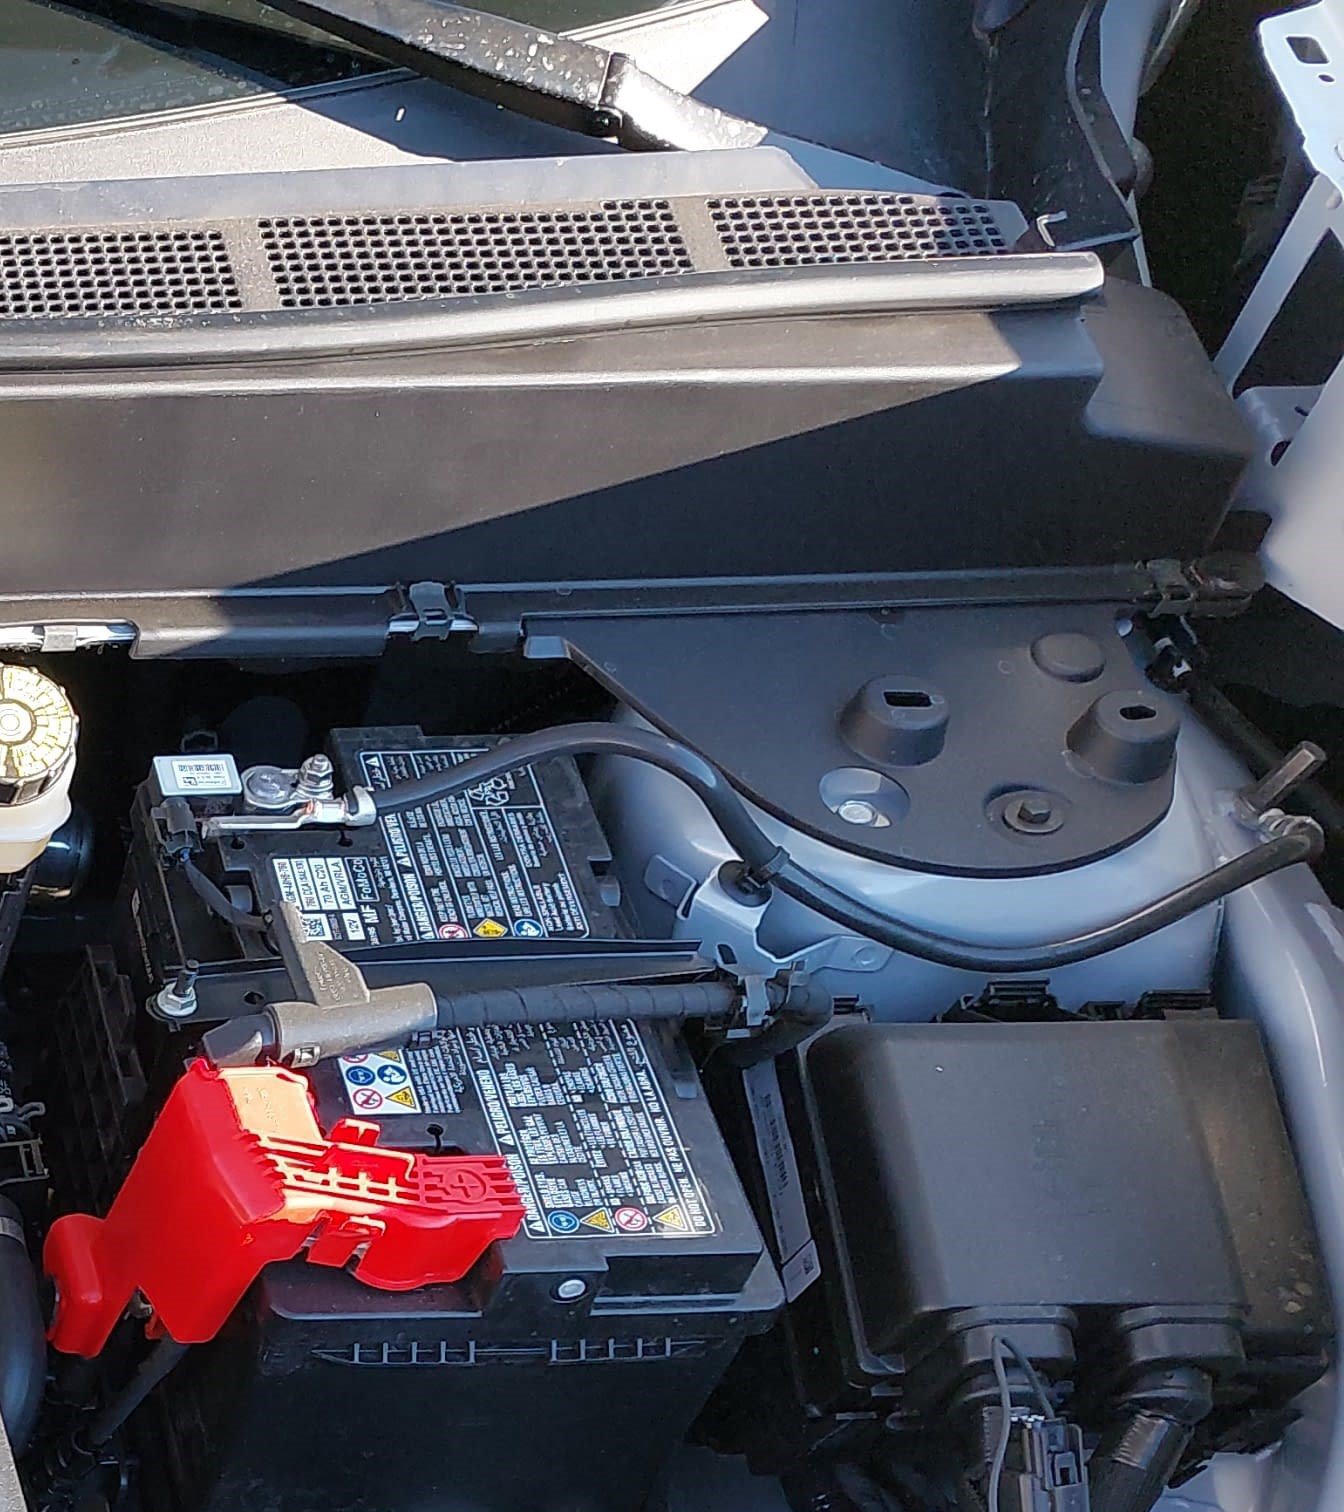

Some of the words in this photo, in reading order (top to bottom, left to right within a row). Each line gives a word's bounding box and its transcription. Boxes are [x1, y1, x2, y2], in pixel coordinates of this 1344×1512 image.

[312, 864, 327, 879] C20
[352, 858, 375, 900] FoMoCo
[317, 881, 331, 892] Ah
[334, 861, 353, 905] AGM/VRLA
[321, 894, 333, 903] 70
[401, 872, 432, 931] DANGER/POISON
[358, 904, 380, 923] MF
[346, 919, 360, 933] 12V
[474, 1069, 511, 1133] PELIGRO/VENENO
[647, 1101, 662, 1112] NO
[652, 1115, 674, 1145] OUVRIR.
[664, 1147, 680, 1161] PAS
[670, 1162, 685, 1172] NE
[683, 1198, 702, 1214] NOT
[691, 1215, 707, 1226] DO
